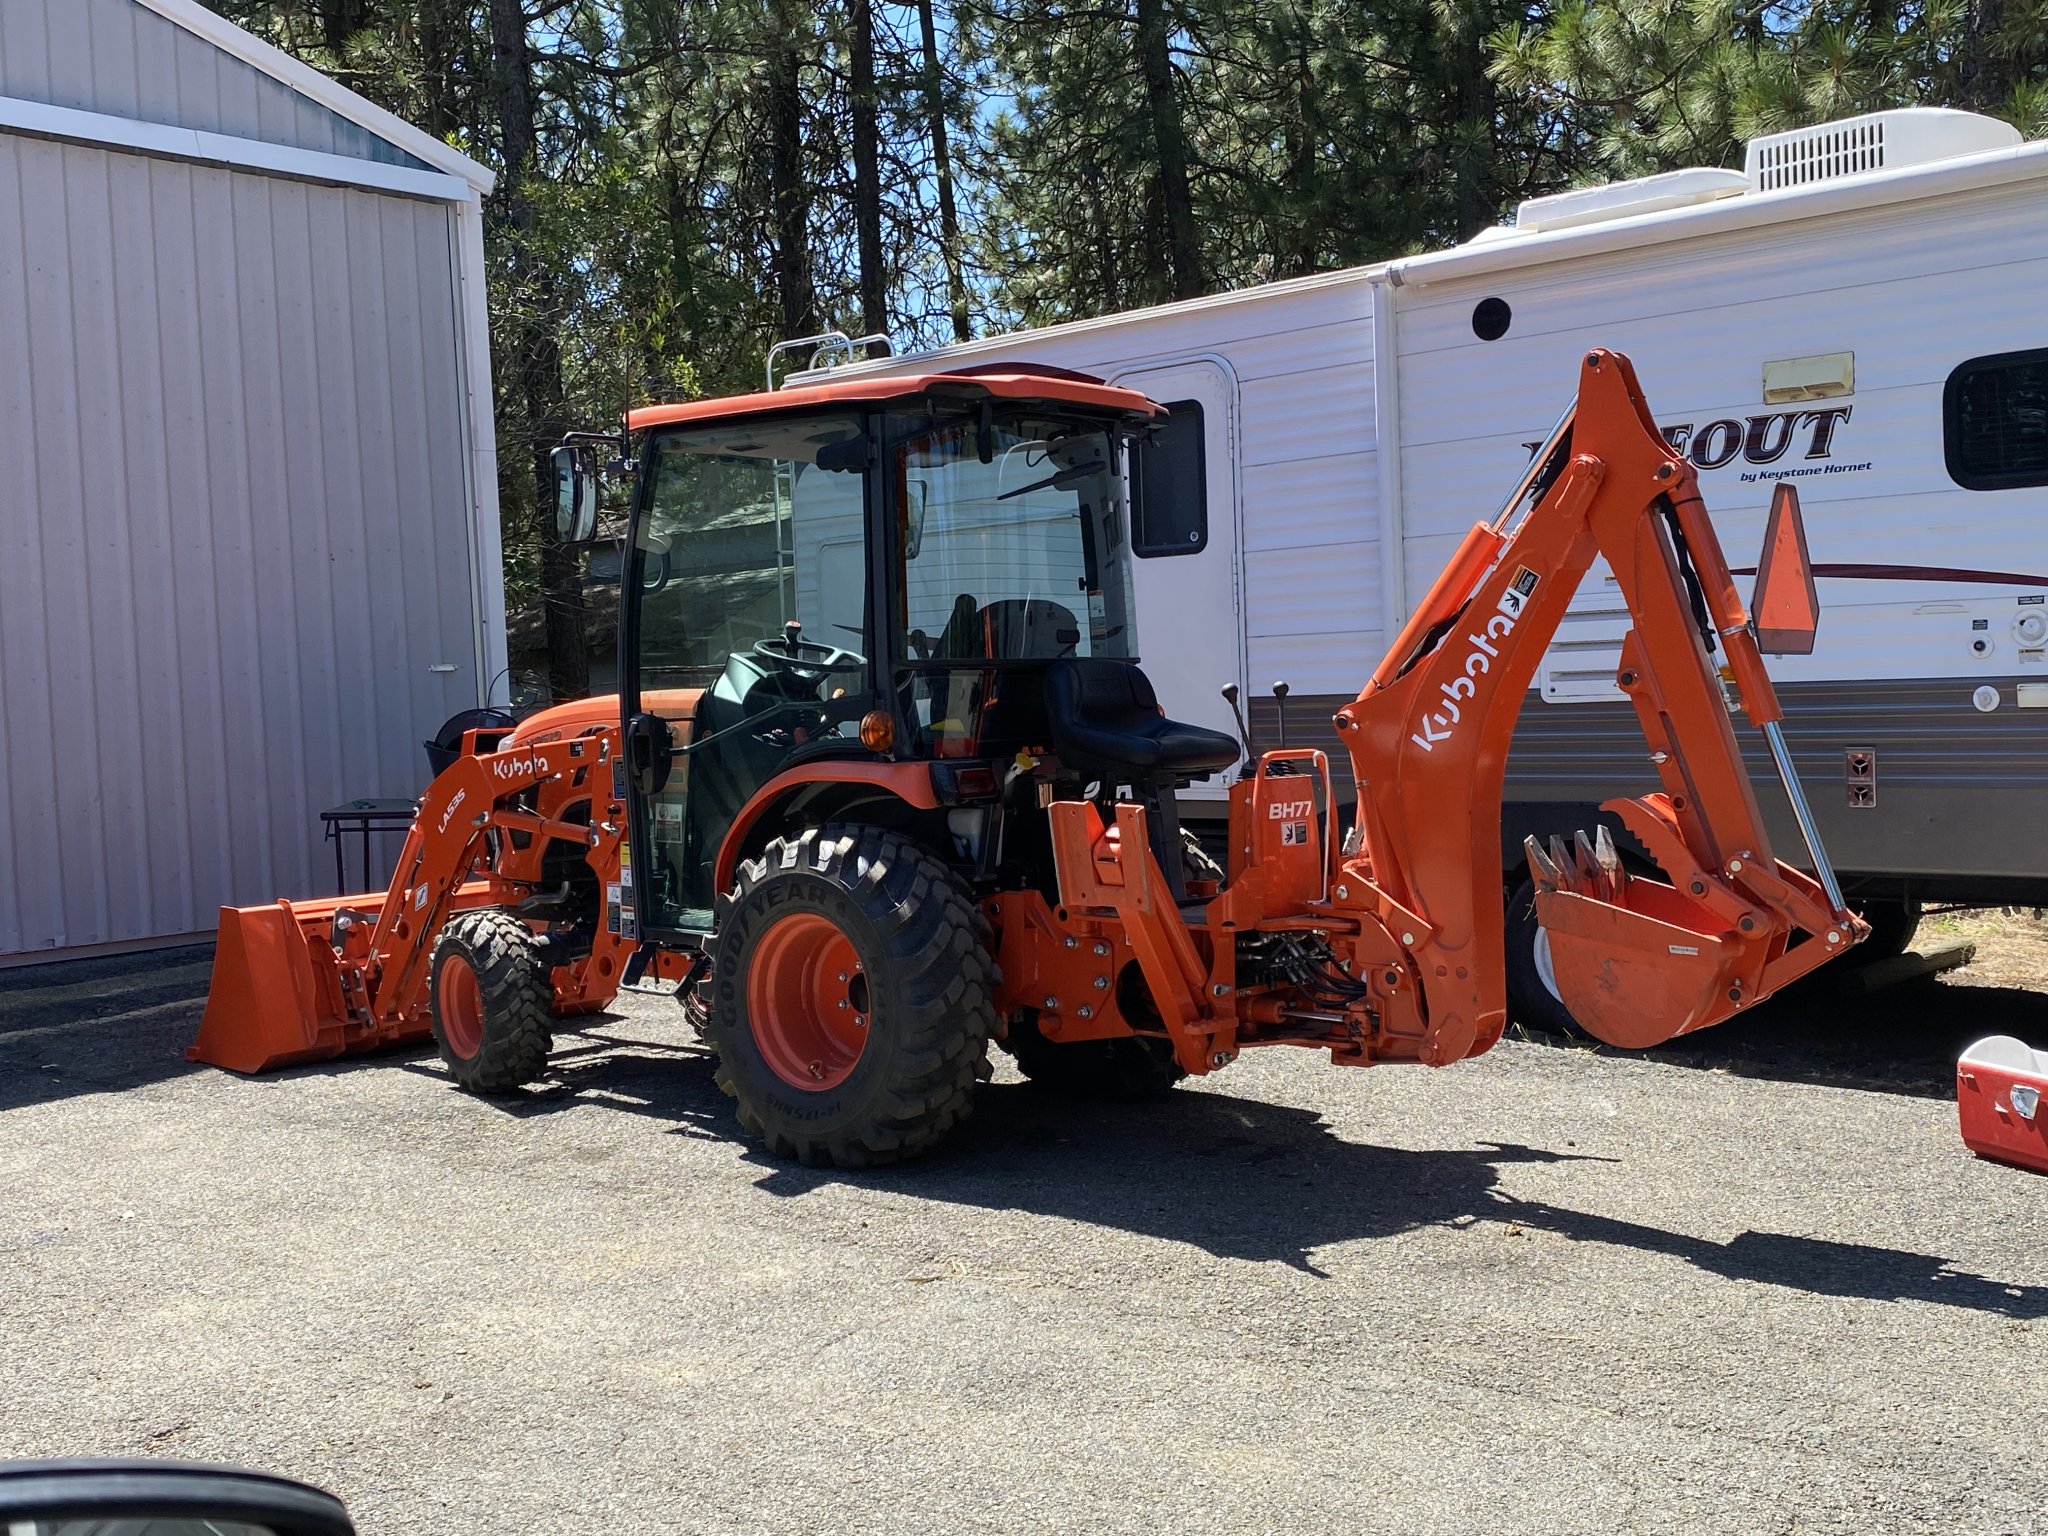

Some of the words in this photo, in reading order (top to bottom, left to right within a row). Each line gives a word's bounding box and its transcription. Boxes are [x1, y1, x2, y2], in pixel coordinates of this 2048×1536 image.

[1522, 405, 1853, 470] EOUT
[1740, 472, 1757, 483] by
[1758, 468, 1822, 481] Keystone
[1824, 462, 1872, 474] Hornet
[1411, 615, 1515, 752] Kubota
[493, 753, 549, 779] Kubota
[438, 787, 466, 834] LA535
[1269, 800, 1312, 820] BH77
